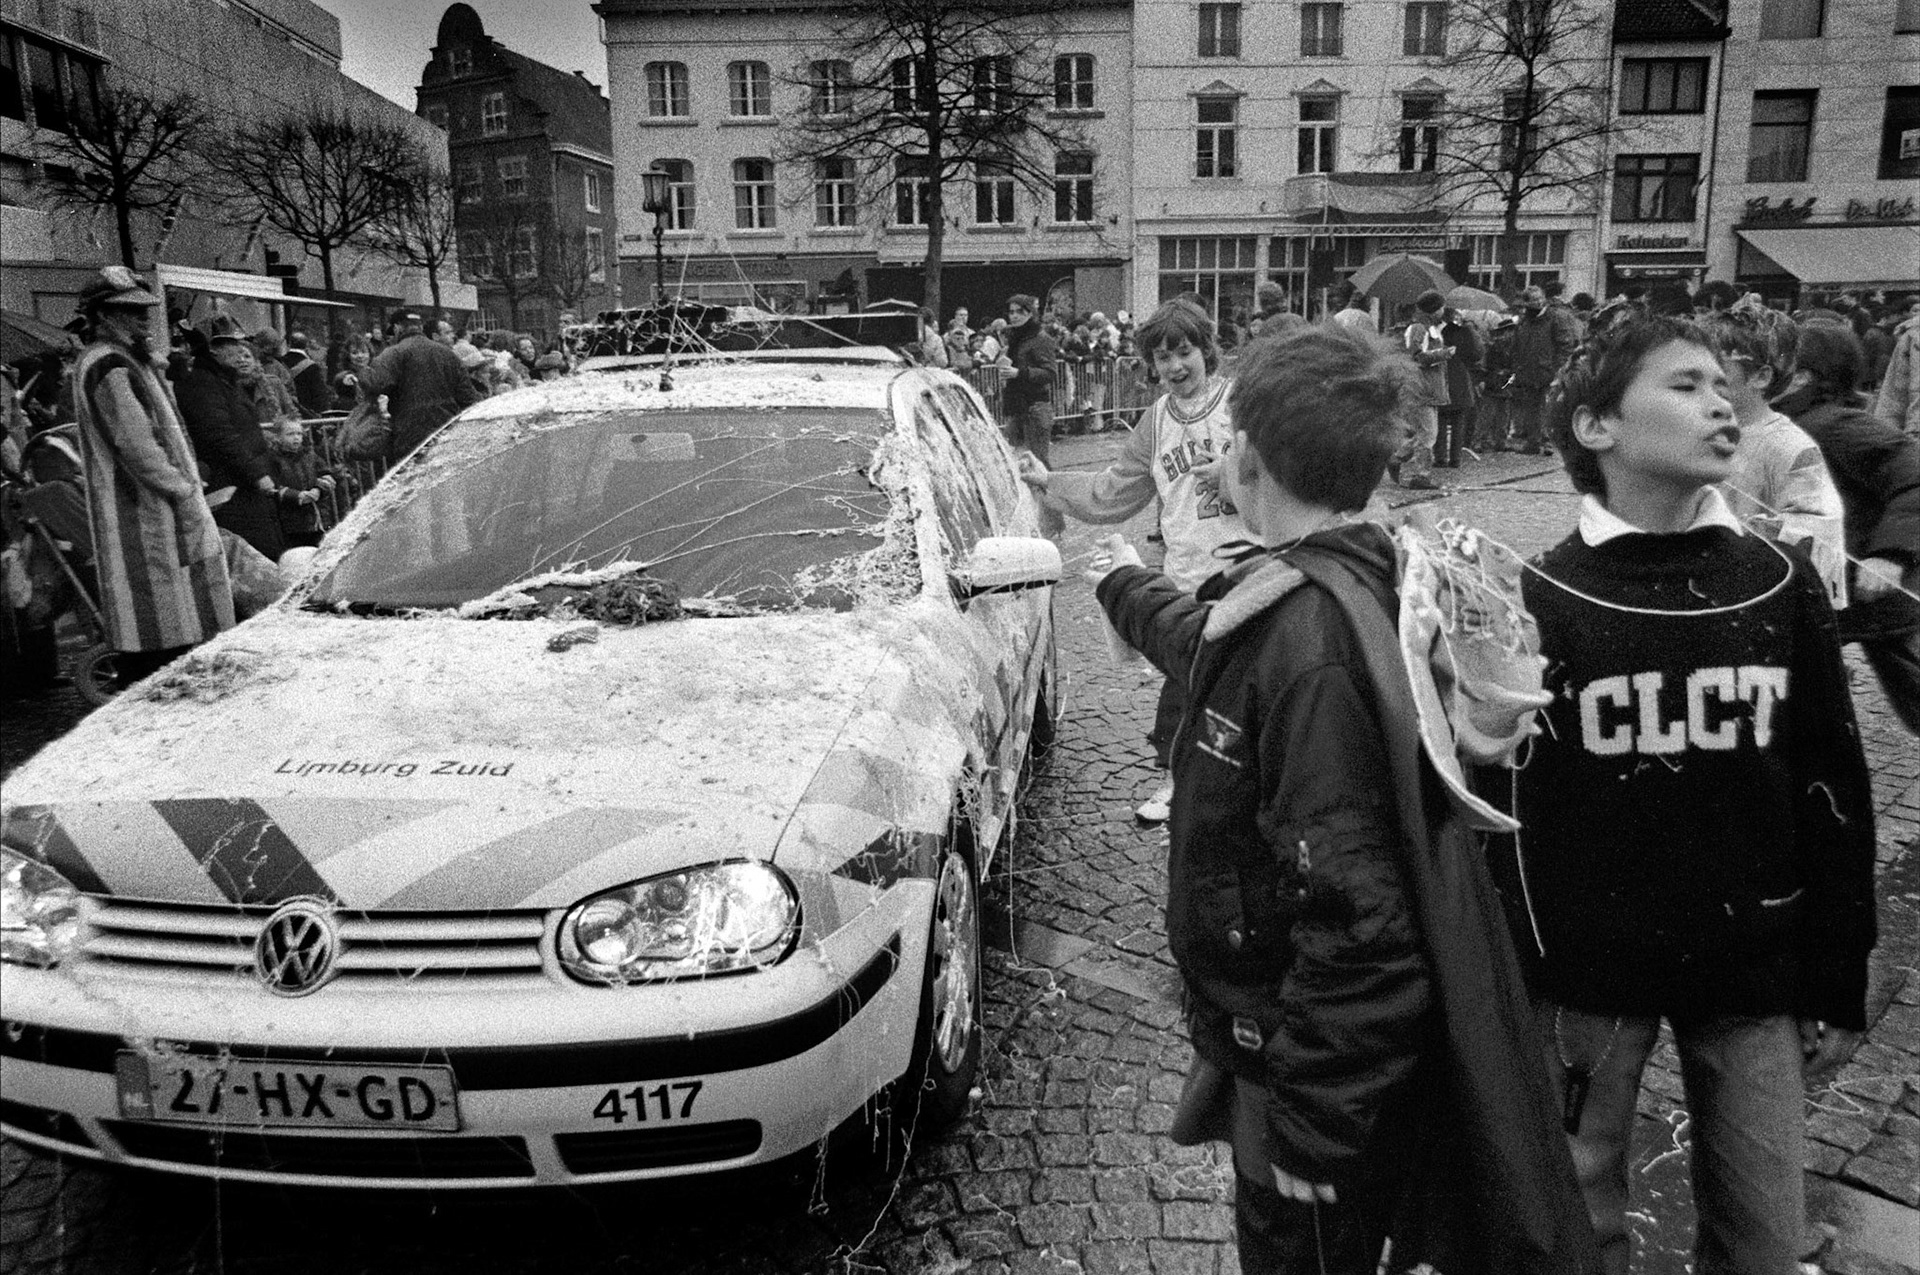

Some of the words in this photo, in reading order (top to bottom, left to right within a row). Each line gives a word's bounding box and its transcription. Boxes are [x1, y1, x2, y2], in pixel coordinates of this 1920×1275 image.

[1579, 665, 1788, 755] CLCT
[274, 758, 419, 778] Limburg
[430, 760, 515, 777] Zuid
[171, 1066, 437, 1122] 27-HX-GD
[592, 1081, 703, 1123] 4117
